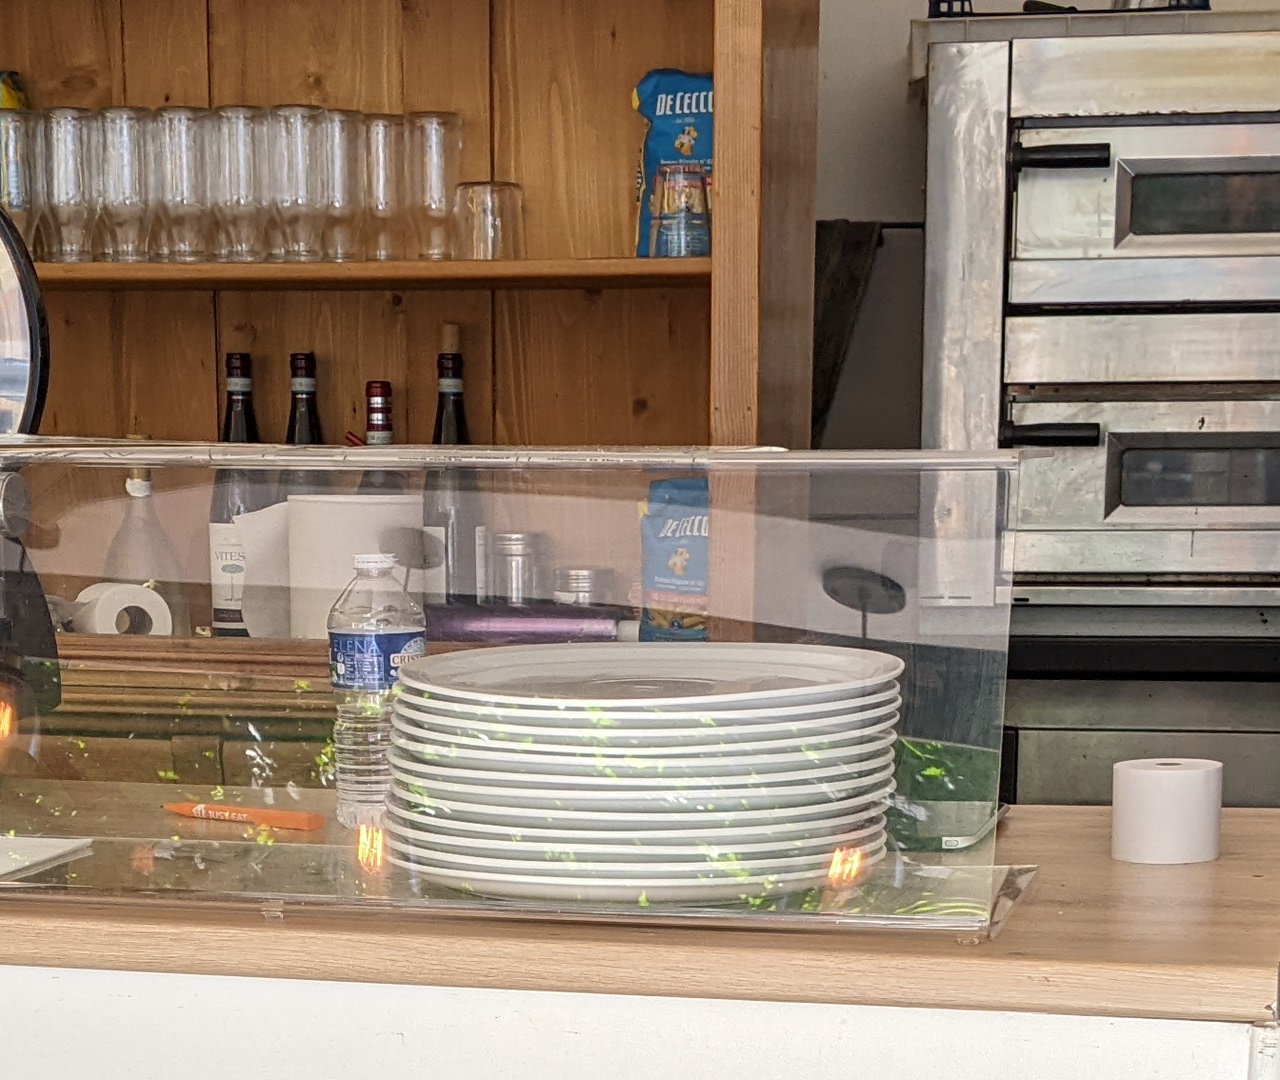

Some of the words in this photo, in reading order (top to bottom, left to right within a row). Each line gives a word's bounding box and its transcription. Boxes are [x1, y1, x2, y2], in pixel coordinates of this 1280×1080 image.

[655, 93, 674, 116] DE
[658, 519, 680, 537] DE
[231, 812, 249, 821] EAT
